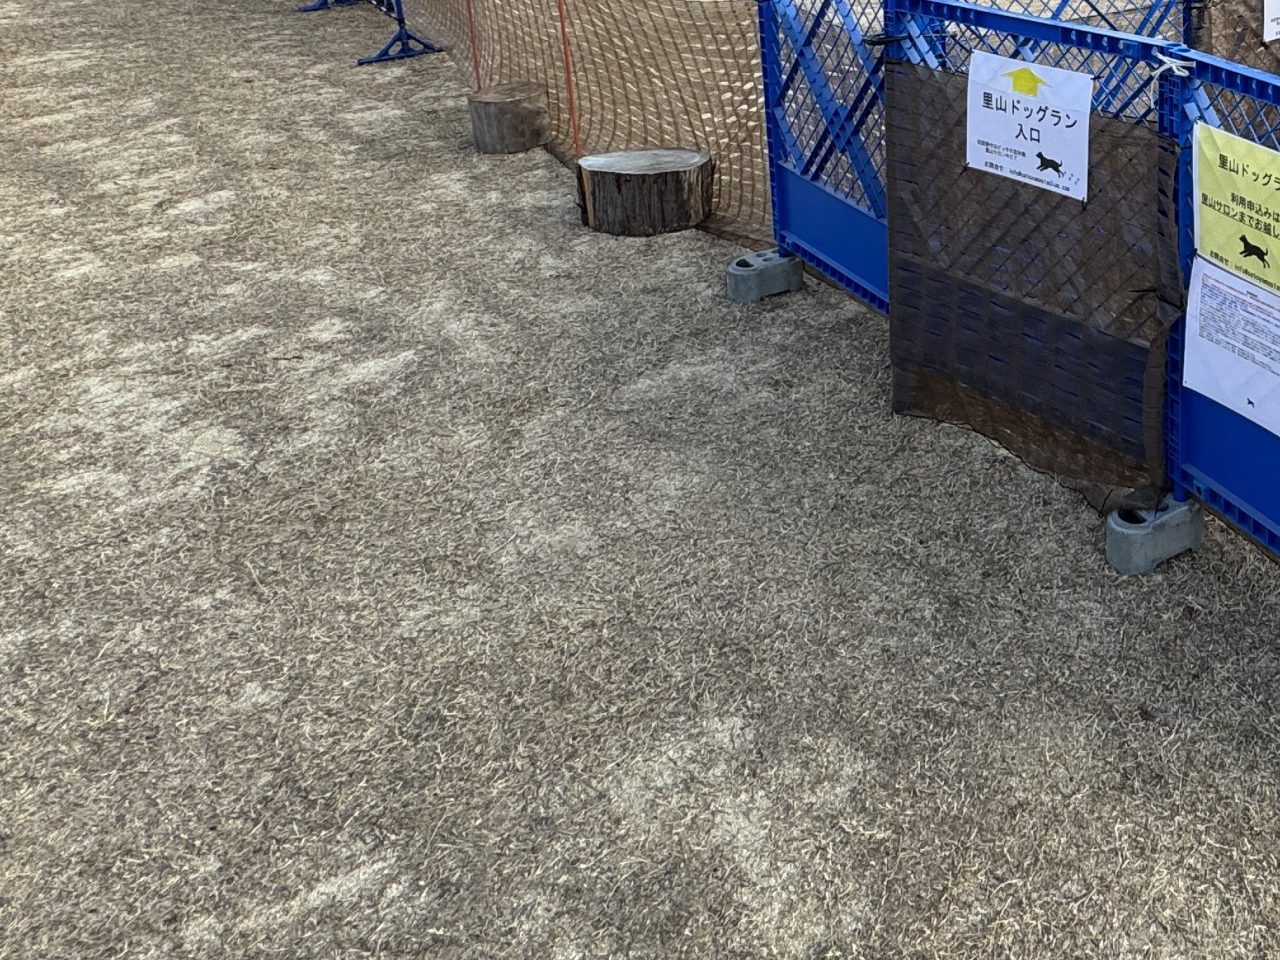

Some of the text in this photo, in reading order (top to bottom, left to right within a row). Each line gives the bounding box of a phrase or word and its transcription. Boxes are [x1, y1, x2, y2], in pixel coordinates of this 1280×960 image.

[982, 91, 1078, 128] 里山ドッグラン
[1015, 123, 1041, 143] 入口
[1230, 192, 1280, 223] 利用申込みは
